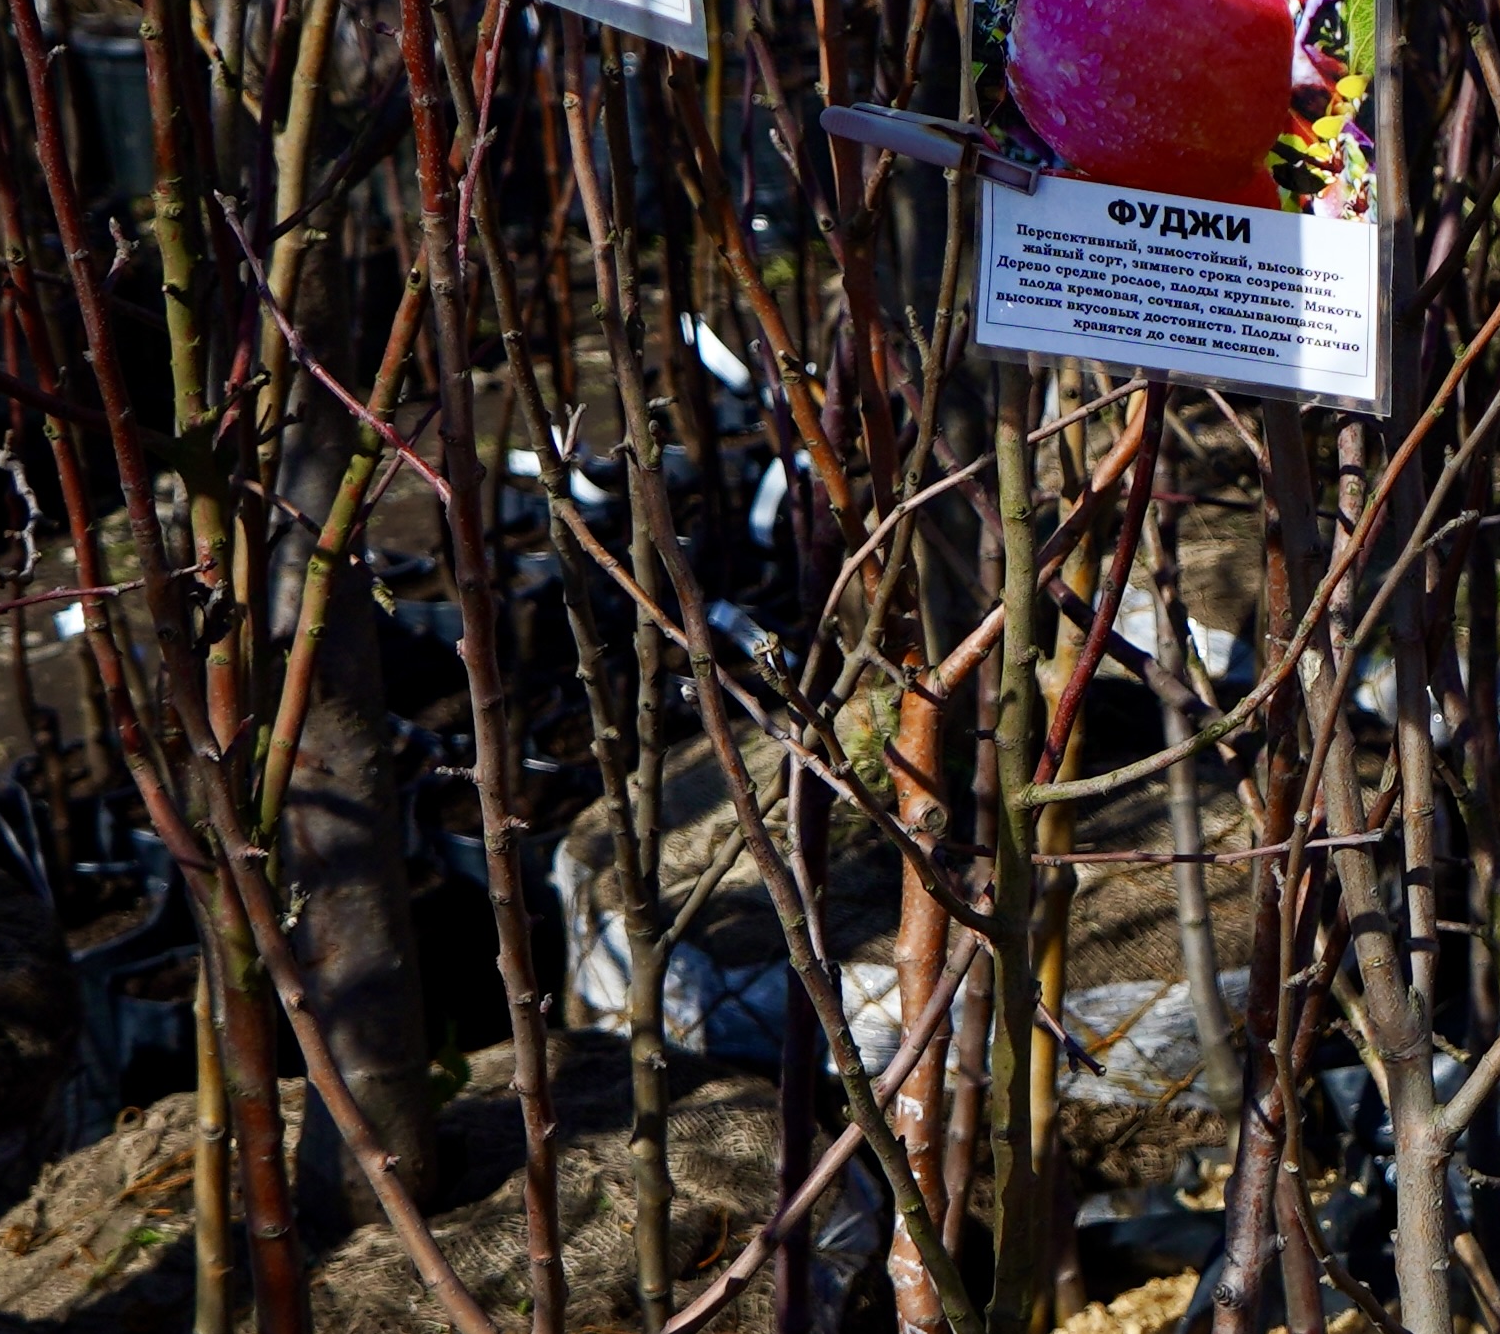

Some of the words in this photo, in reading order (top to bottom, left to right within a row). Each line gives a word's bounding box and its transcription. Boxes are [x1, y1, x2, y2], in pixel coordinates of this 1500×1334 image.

[1107, 199, 1250, 243] ФУДЖИ
[1016, 223, 1142, 254] Перспективный,
[1146, 244, 1252, 270] зимостойкий,
[1257, 261, 1344, 283] высокоуро-
[1021, 242, 1084, 261] жайный
[1088, 253, 1128, 269] сорт,
[1131, 259, 1194, 277] зимнего
[1198, 269, 1242, 284] срока
[1245, 276, 1336, 297] созревания.
[995, 254, 1052, 273] Дерево
[1054, 265, 1106, 281] средне
[1110, 273, 1166, 291] рослое,
[1169, 282, 1219, 298] плоды
[1223, 289, 1294, 309] крупные.
[1303, 299, 1362, 319] Мякоть
[1018, 277, 1063, 293] плода
[1066, 284, 1144, 305] кремовая,
[1147, 295, 1204, 315] сочная,
[1208, 304, 1338, 333] скалывающаяся,
[995, 291, 1062, 309] высоких
[1066, 300, 1140, 320] вкусовых
[1142, 312, 1236, 334] достоинств.
[1241, 323, 1292, 343] Плоды
[1295, 335, 1360, 353] отлично
[1071, 318, 1142, 339] хранятся
[1145, 329, 1164, 341] до
[1168, 332, 1208, 347] семи
[1211, 338, 1280, 357] месяцев.
